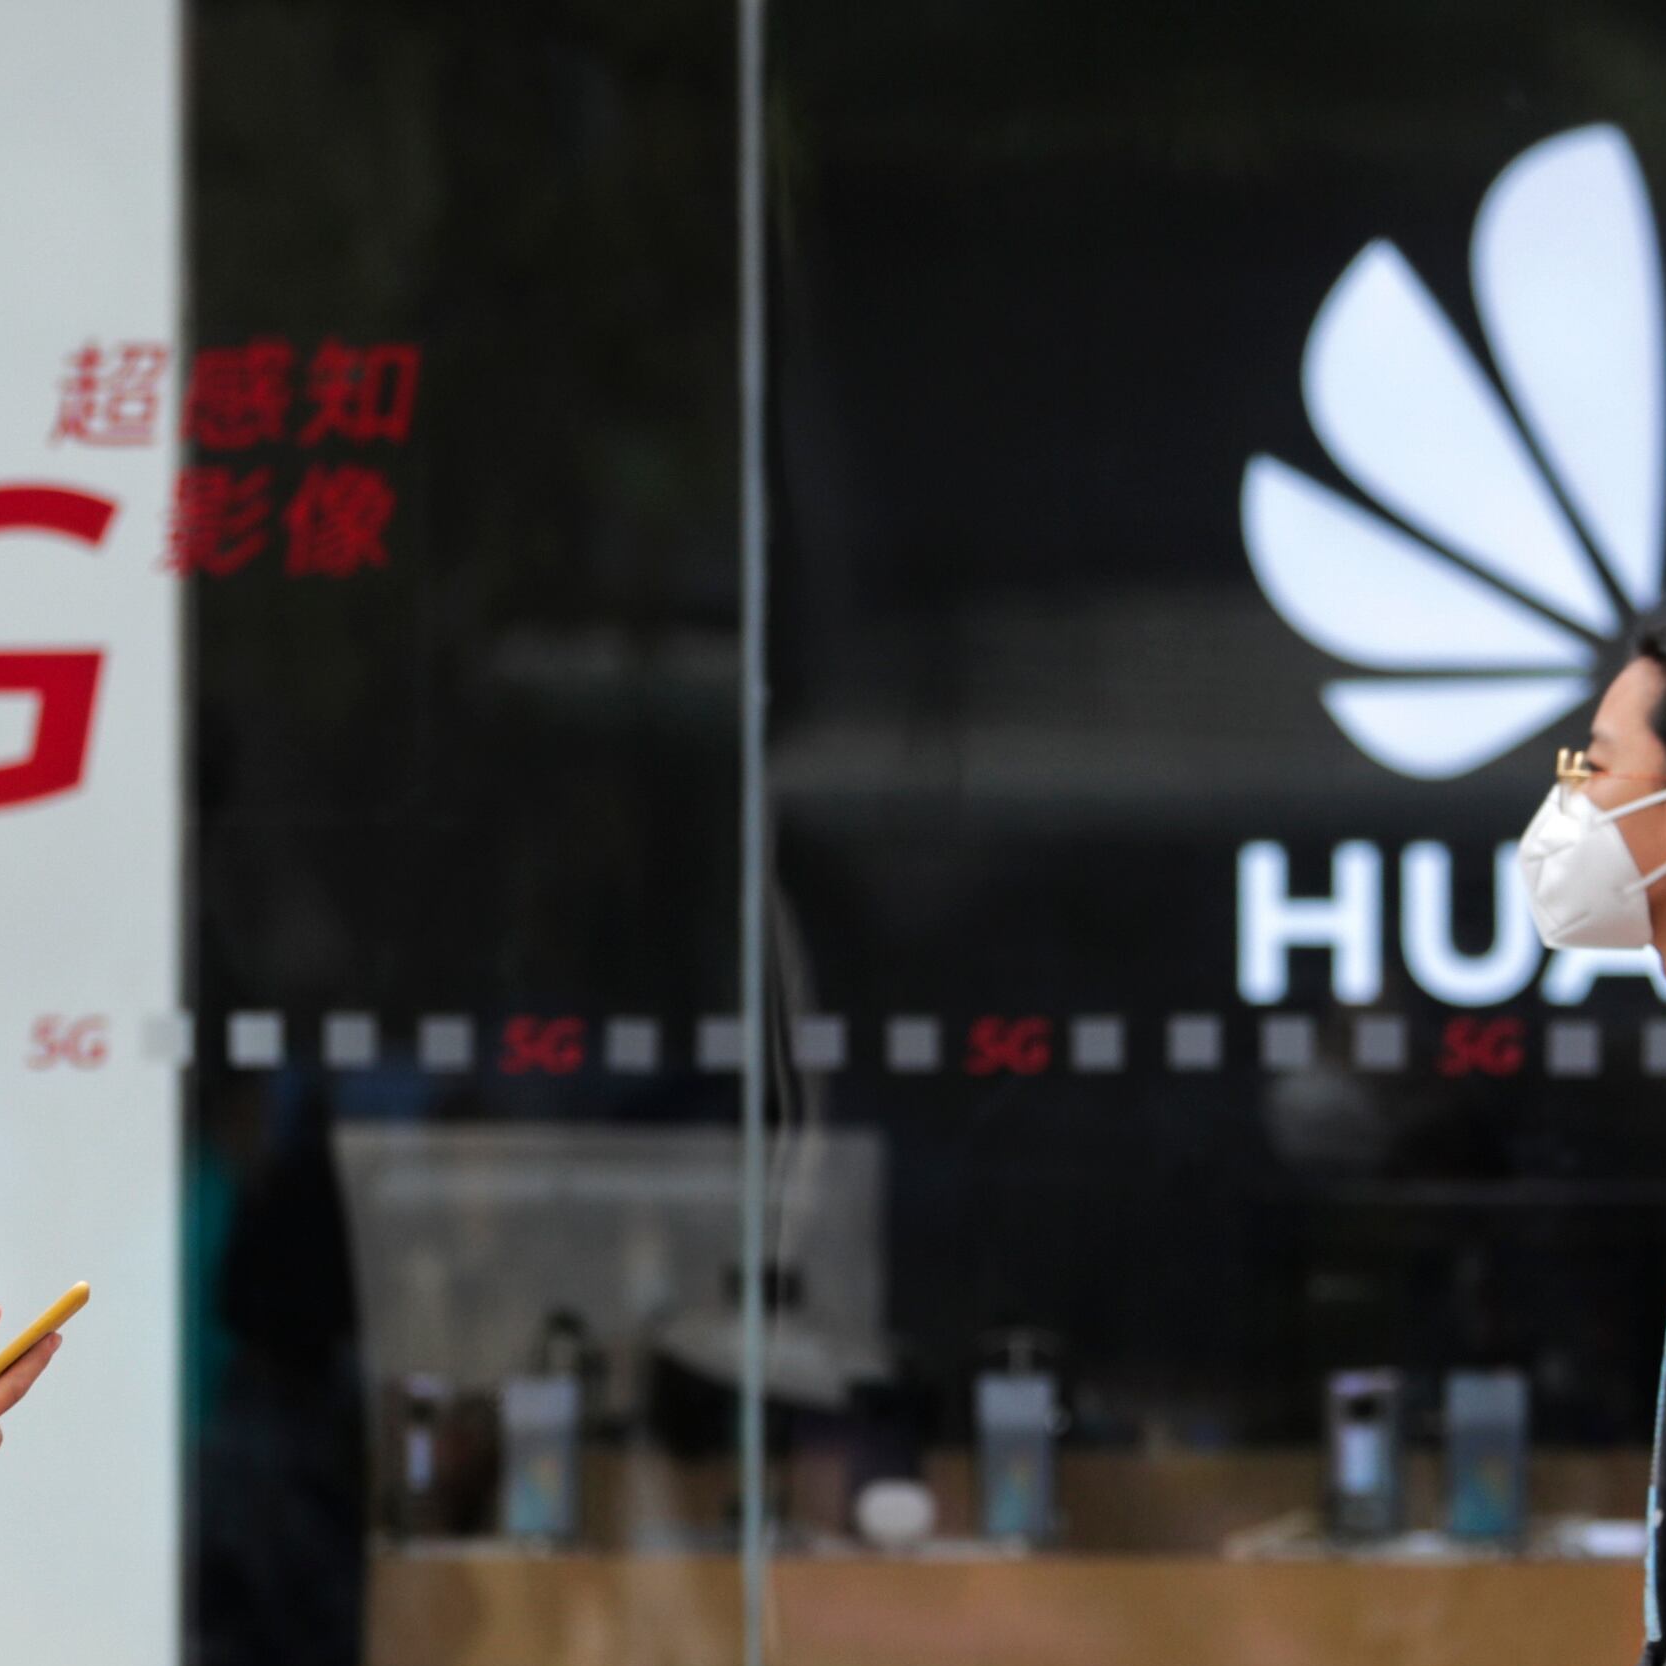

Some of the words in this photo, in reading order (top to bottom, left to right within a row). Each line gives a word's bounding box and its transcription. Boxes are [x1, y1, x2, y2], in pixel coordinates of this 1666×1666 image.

[49, 336, 421, 448] 超感知
[159, 464, 397, 580] 影像
[29, 1017, 108, 1069] 5G
[499, 1015, 586, 1074] 5G
[967, 1016, 1052, 1075] 5G
[1439, 1018, 1524, 1076] 5G
